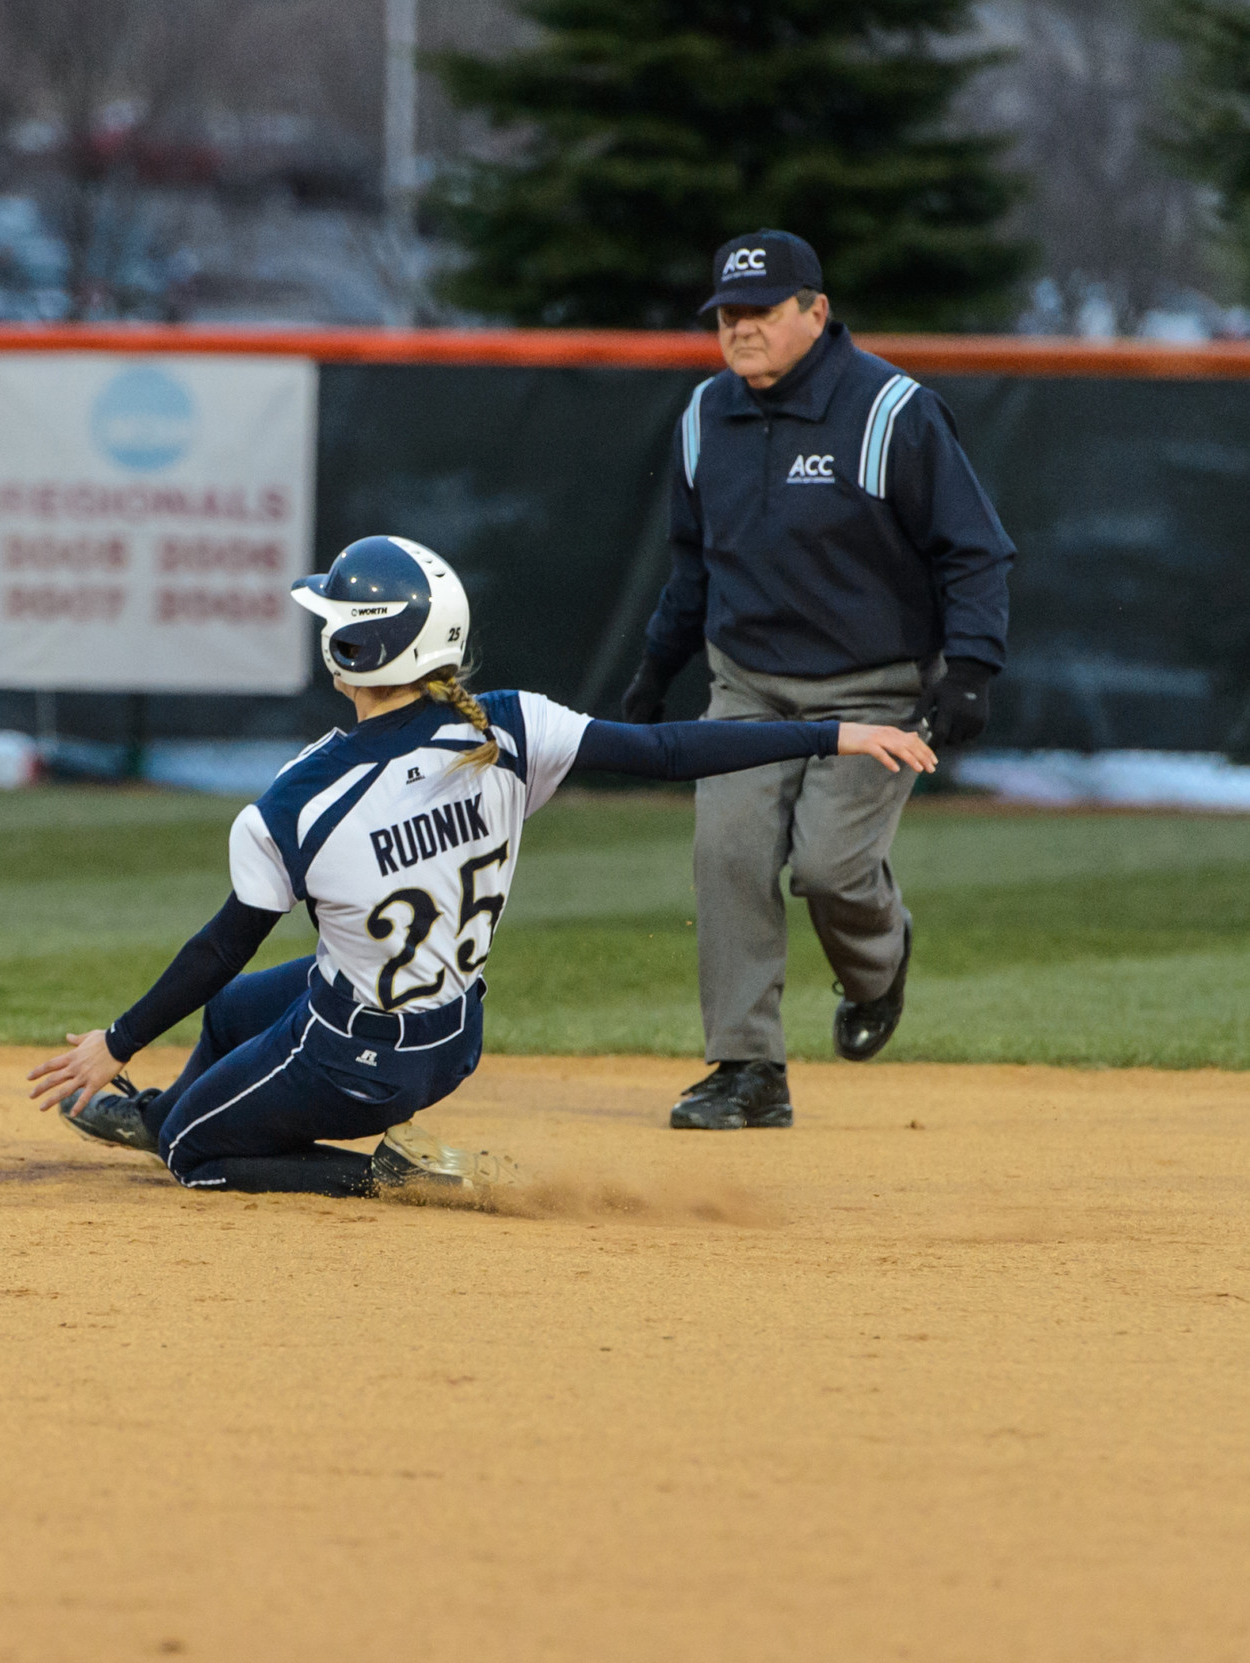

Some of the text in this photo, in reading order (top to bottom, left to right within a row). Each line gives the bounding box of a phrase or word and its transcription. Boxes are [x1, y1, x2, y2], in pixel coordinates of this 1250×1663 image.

[723, 248, 766, 275] ACC
[789, 454, 834, 476] ACC
[358, 606, 388, 616] WORTH
[448, 626, 461, 642] 25
[369, 792, 490, 877] RUDNIK
[366, 838, 510, 1012] 25
